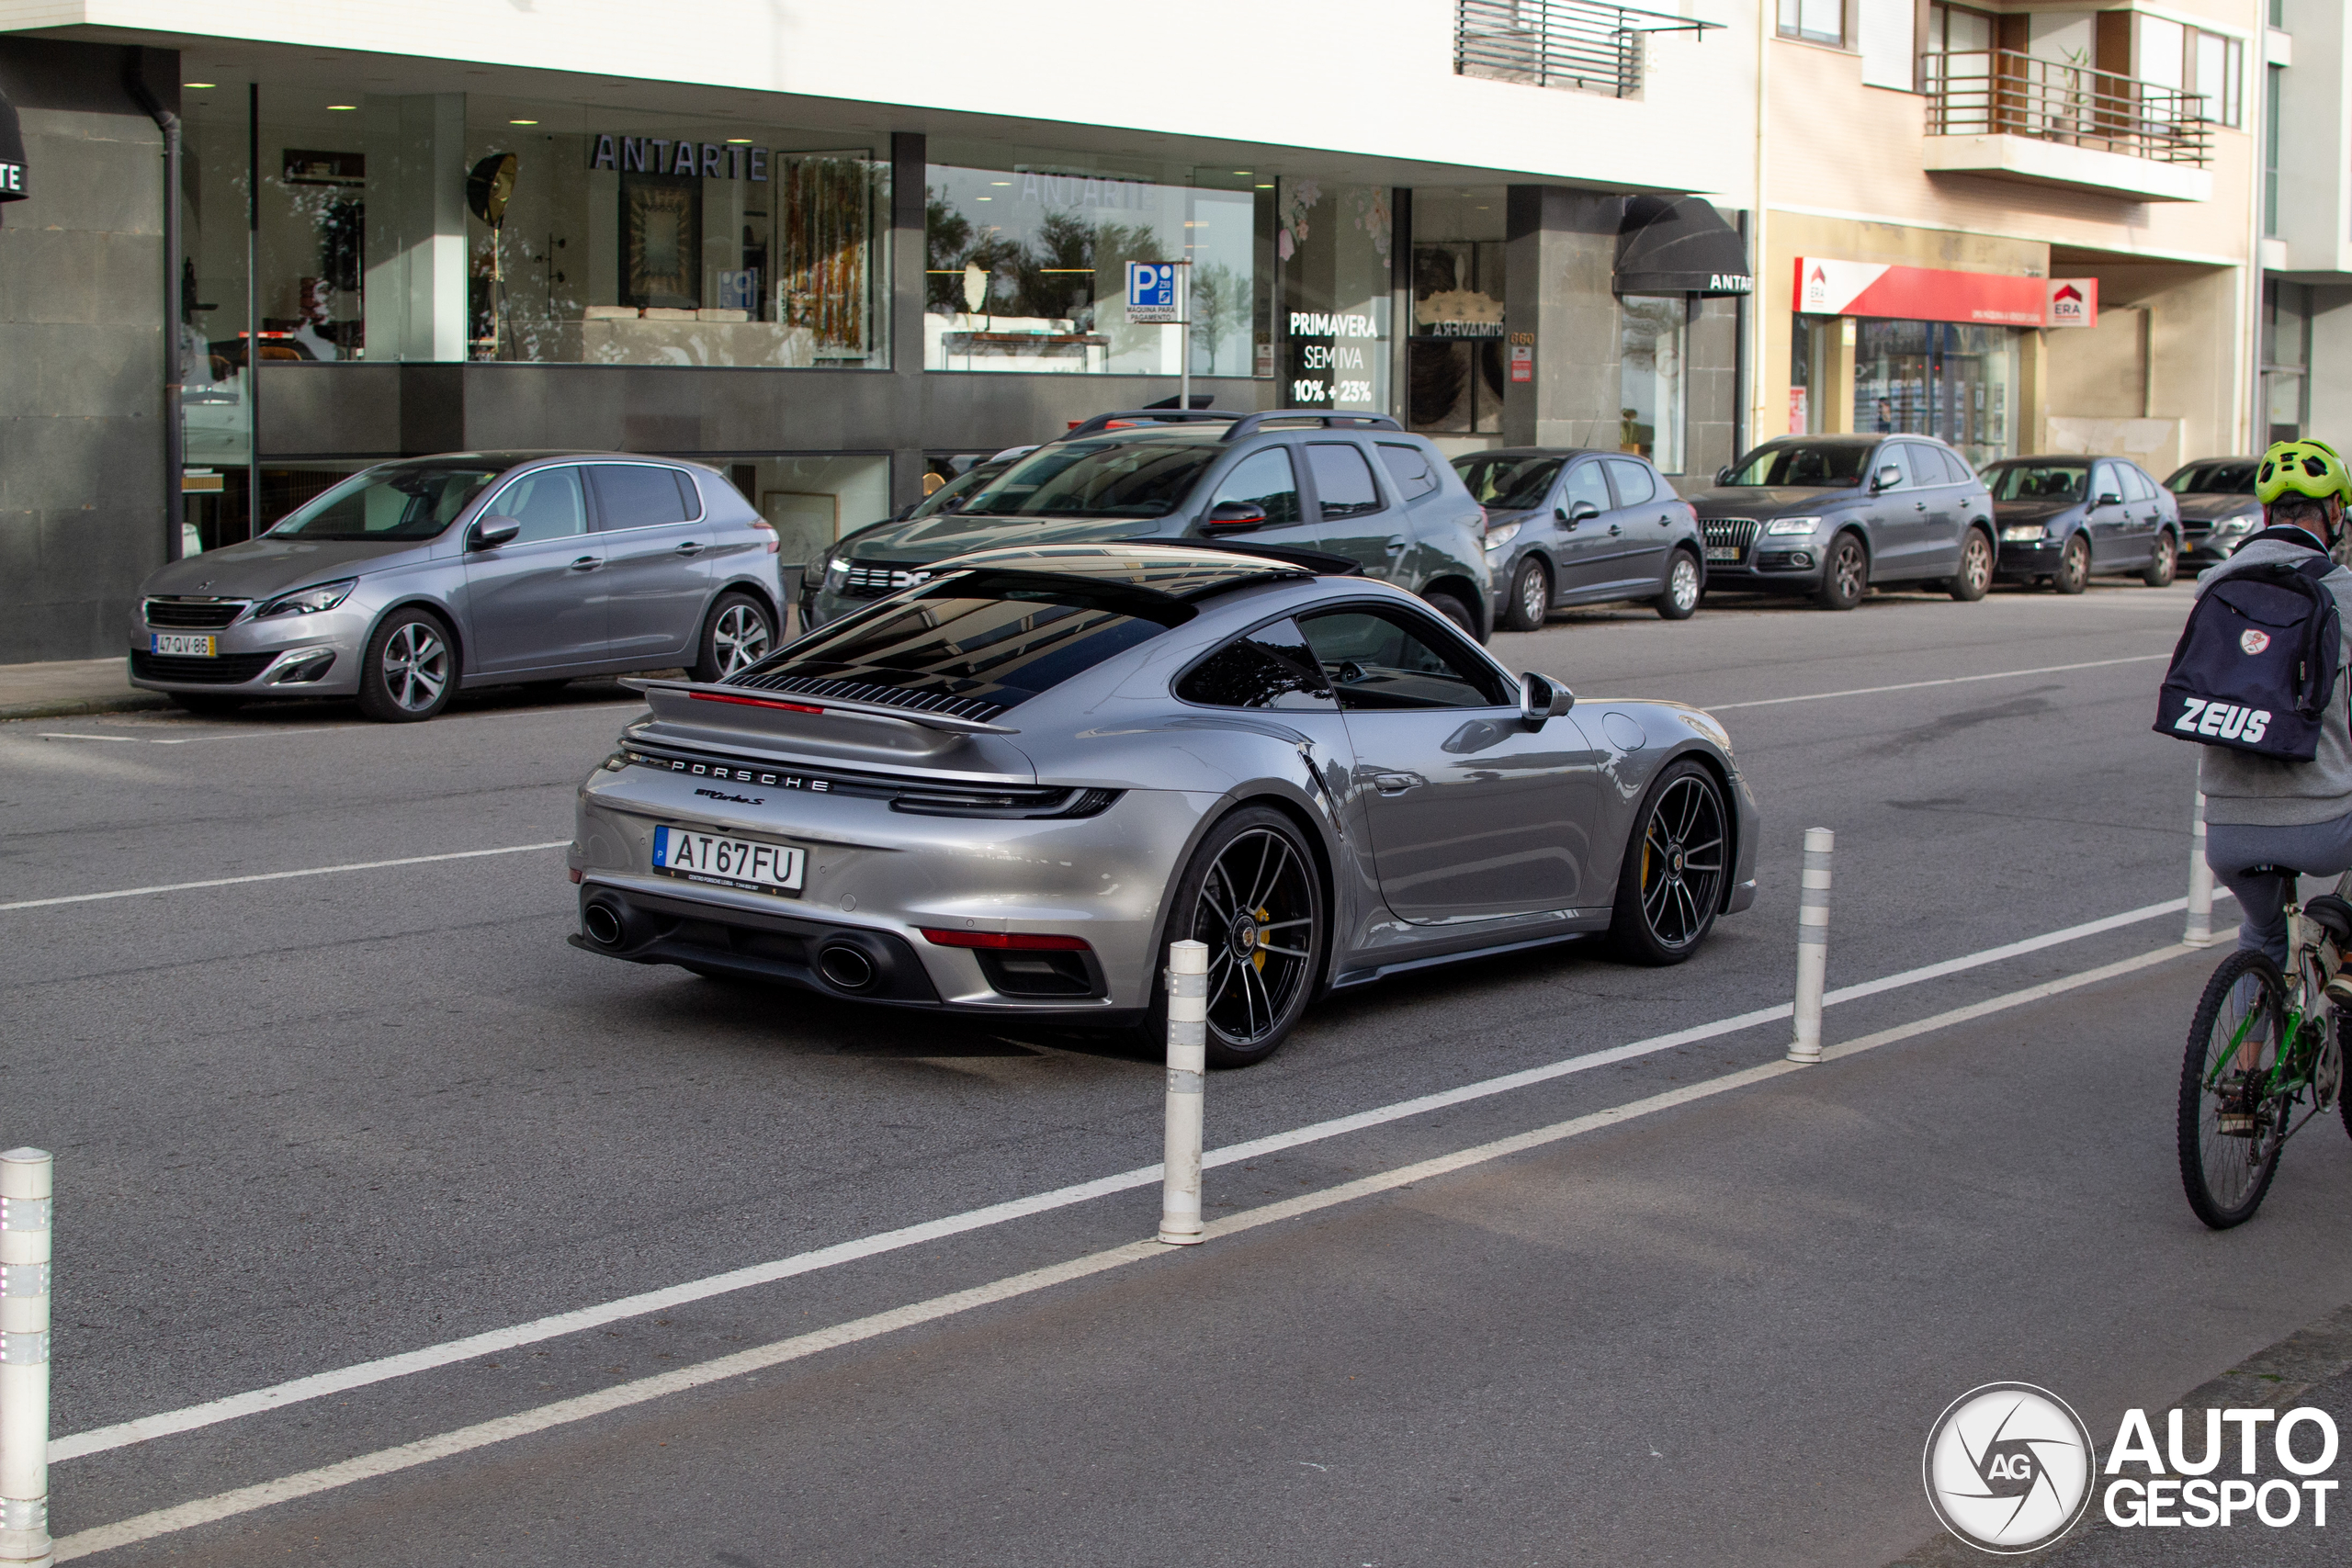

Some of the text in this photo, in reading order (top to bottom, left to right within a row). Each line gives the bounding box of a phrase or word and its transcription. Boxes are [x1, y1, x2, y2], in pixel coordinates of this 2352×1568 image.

[593, 134, 768, 182] ANTARTE
[1132, 265, 1158, 304] P
[2054, 303, 2081, 315] ERA
[1290, 311, 1378, 338] PRIMAVERA
[1510, 333, 1535, 345] 660
[1304, 345, 1364, 369] SEM IVA
[1294, 378, 1372, 401] 10% + 23%
[2174, 696, 2272, 743] ZEUS
[671, 761, 829, 792] PORSCHE
[657, 850, 664, 859] P
[703, 876, 721, 886] PORSCHE
